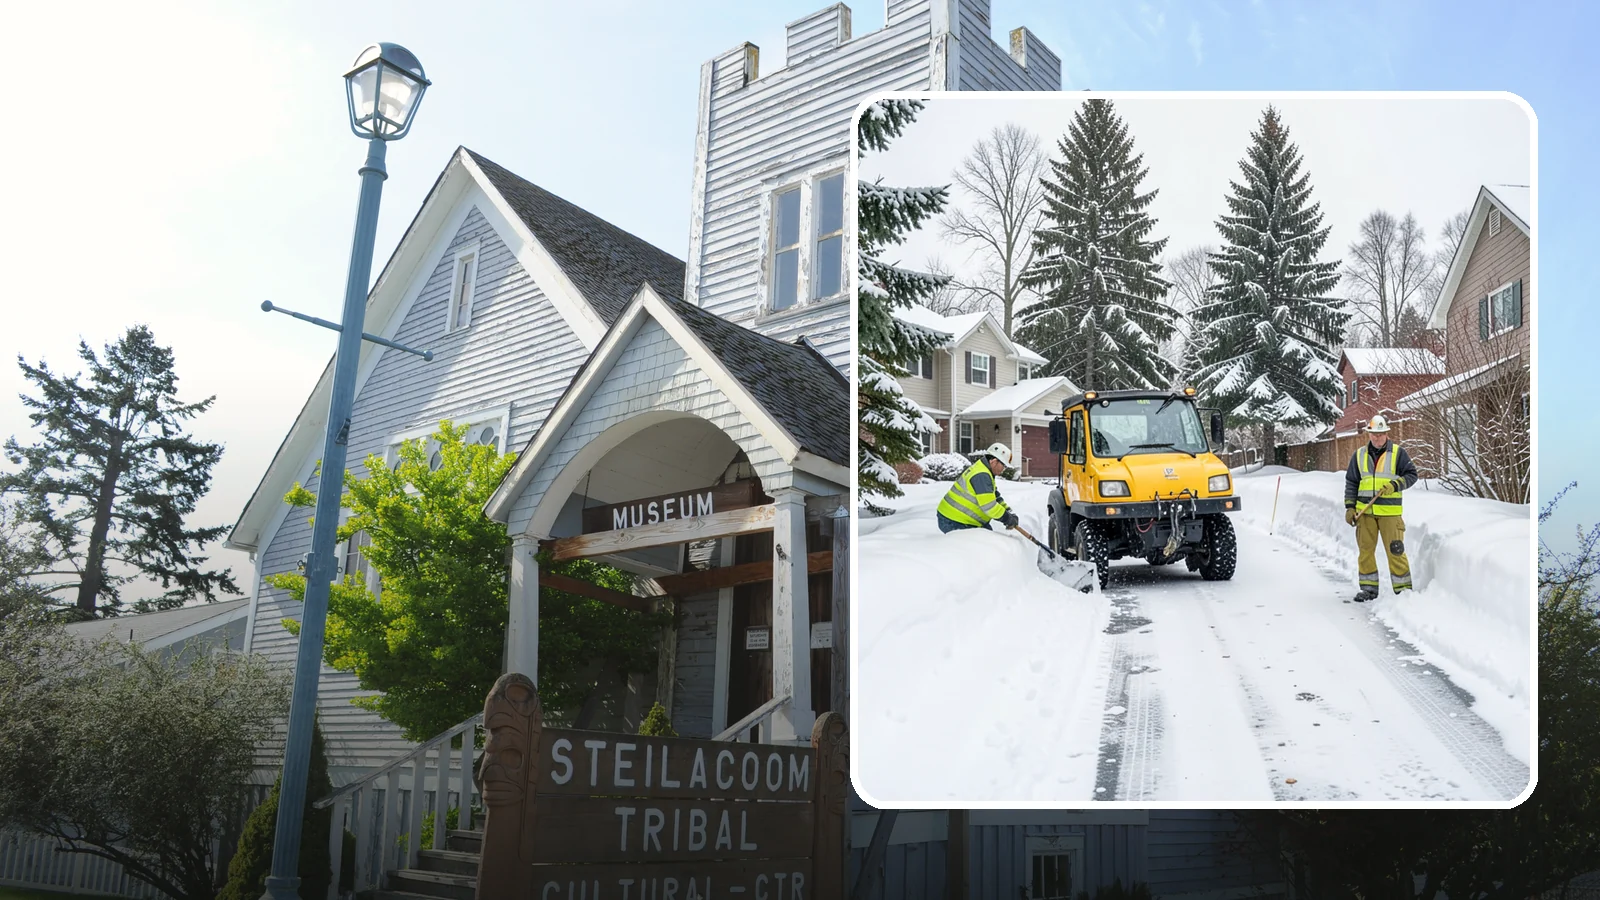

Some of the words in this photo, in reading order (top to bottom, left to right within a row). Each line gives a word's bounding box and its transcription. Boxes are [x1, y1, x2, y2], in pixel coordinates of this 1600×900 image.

[612, 492, 714, 531] MUSEUM
[551, 738, 811, 792] STEILACOOM
[615, 807, 758, 852] TRIBAL
